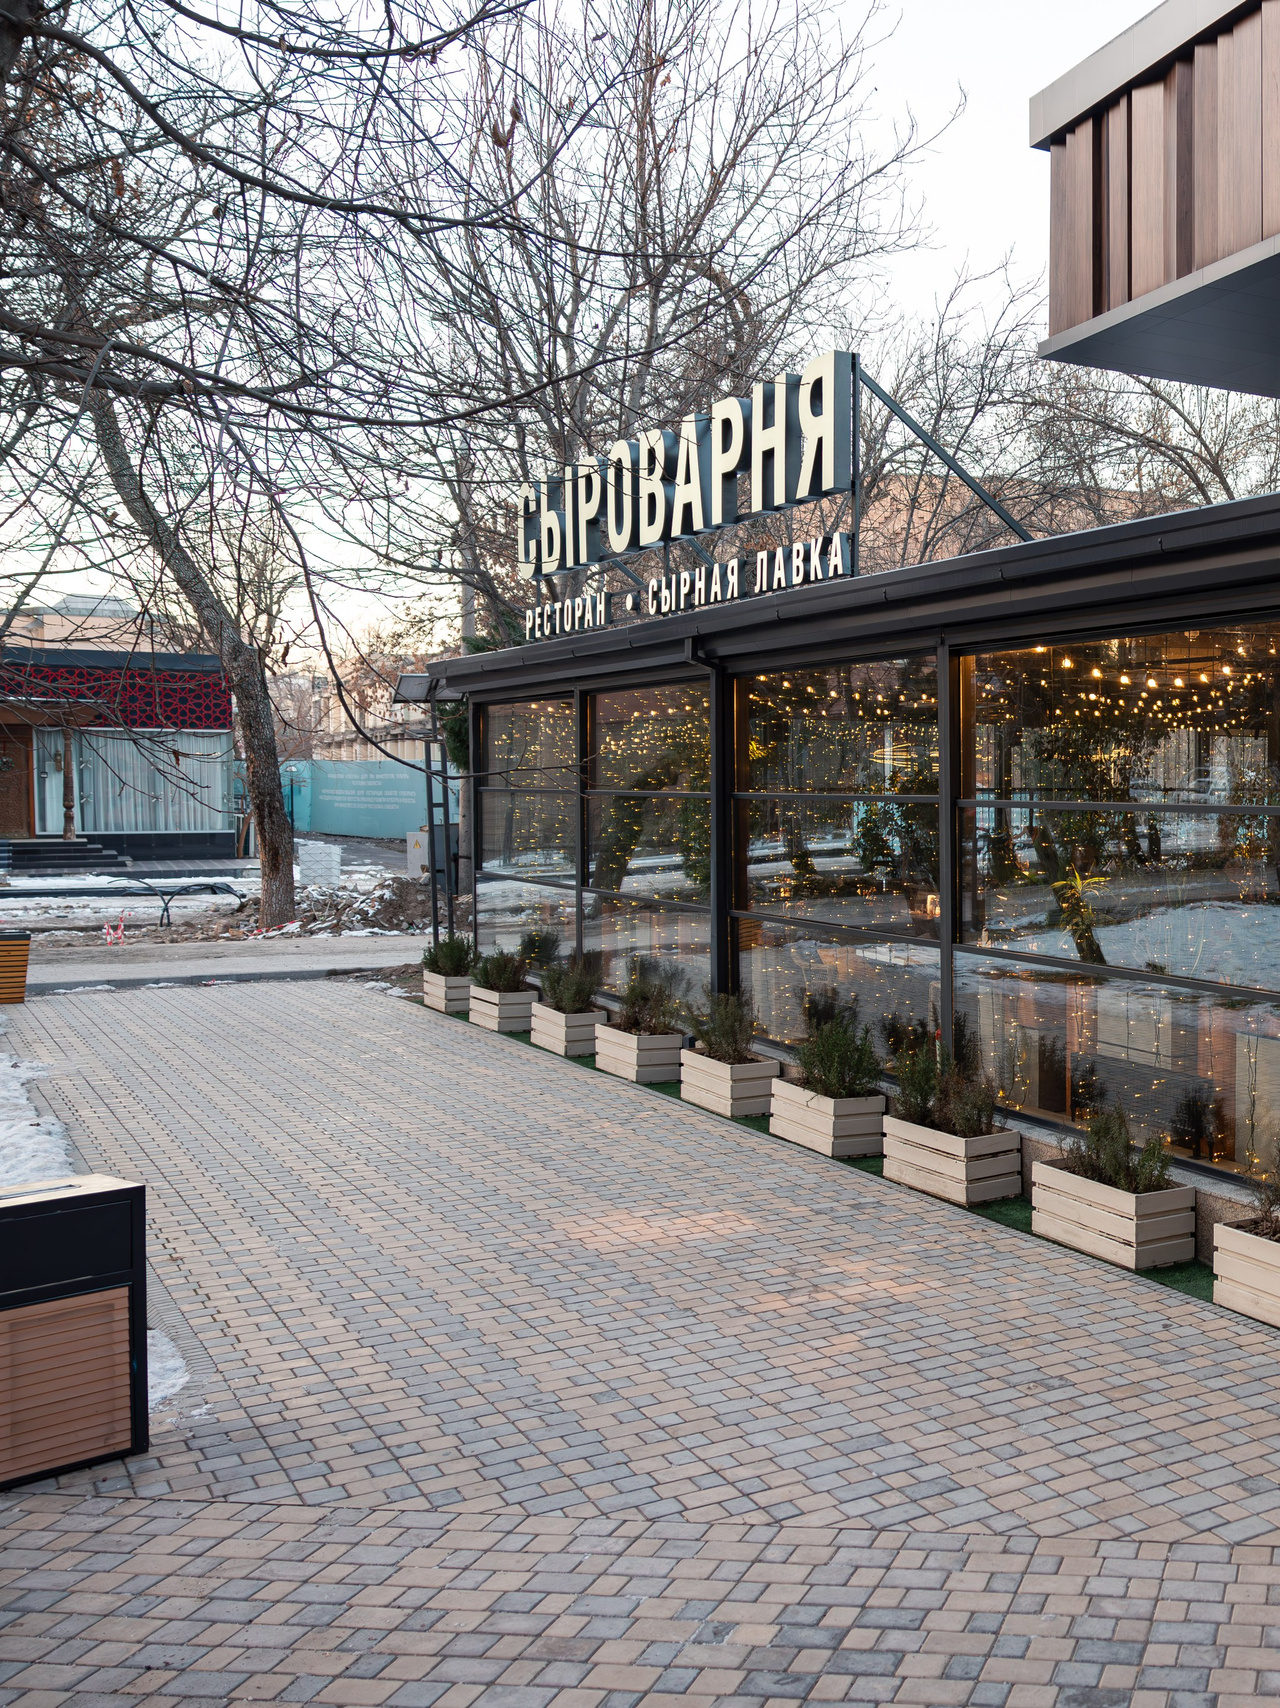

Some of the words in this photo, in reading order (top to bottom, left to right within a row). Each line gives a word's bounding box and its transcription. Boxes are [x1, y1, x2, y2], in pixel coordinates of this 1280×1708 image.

[518, 350, 837, 579] СЫРОВАРНЯ
[525, 591, 607, 641] РЕСТОРАН
[648, 558, 740, 615] СЫРНАЯ
[754, 532, 846, 593] ЛАВКА
